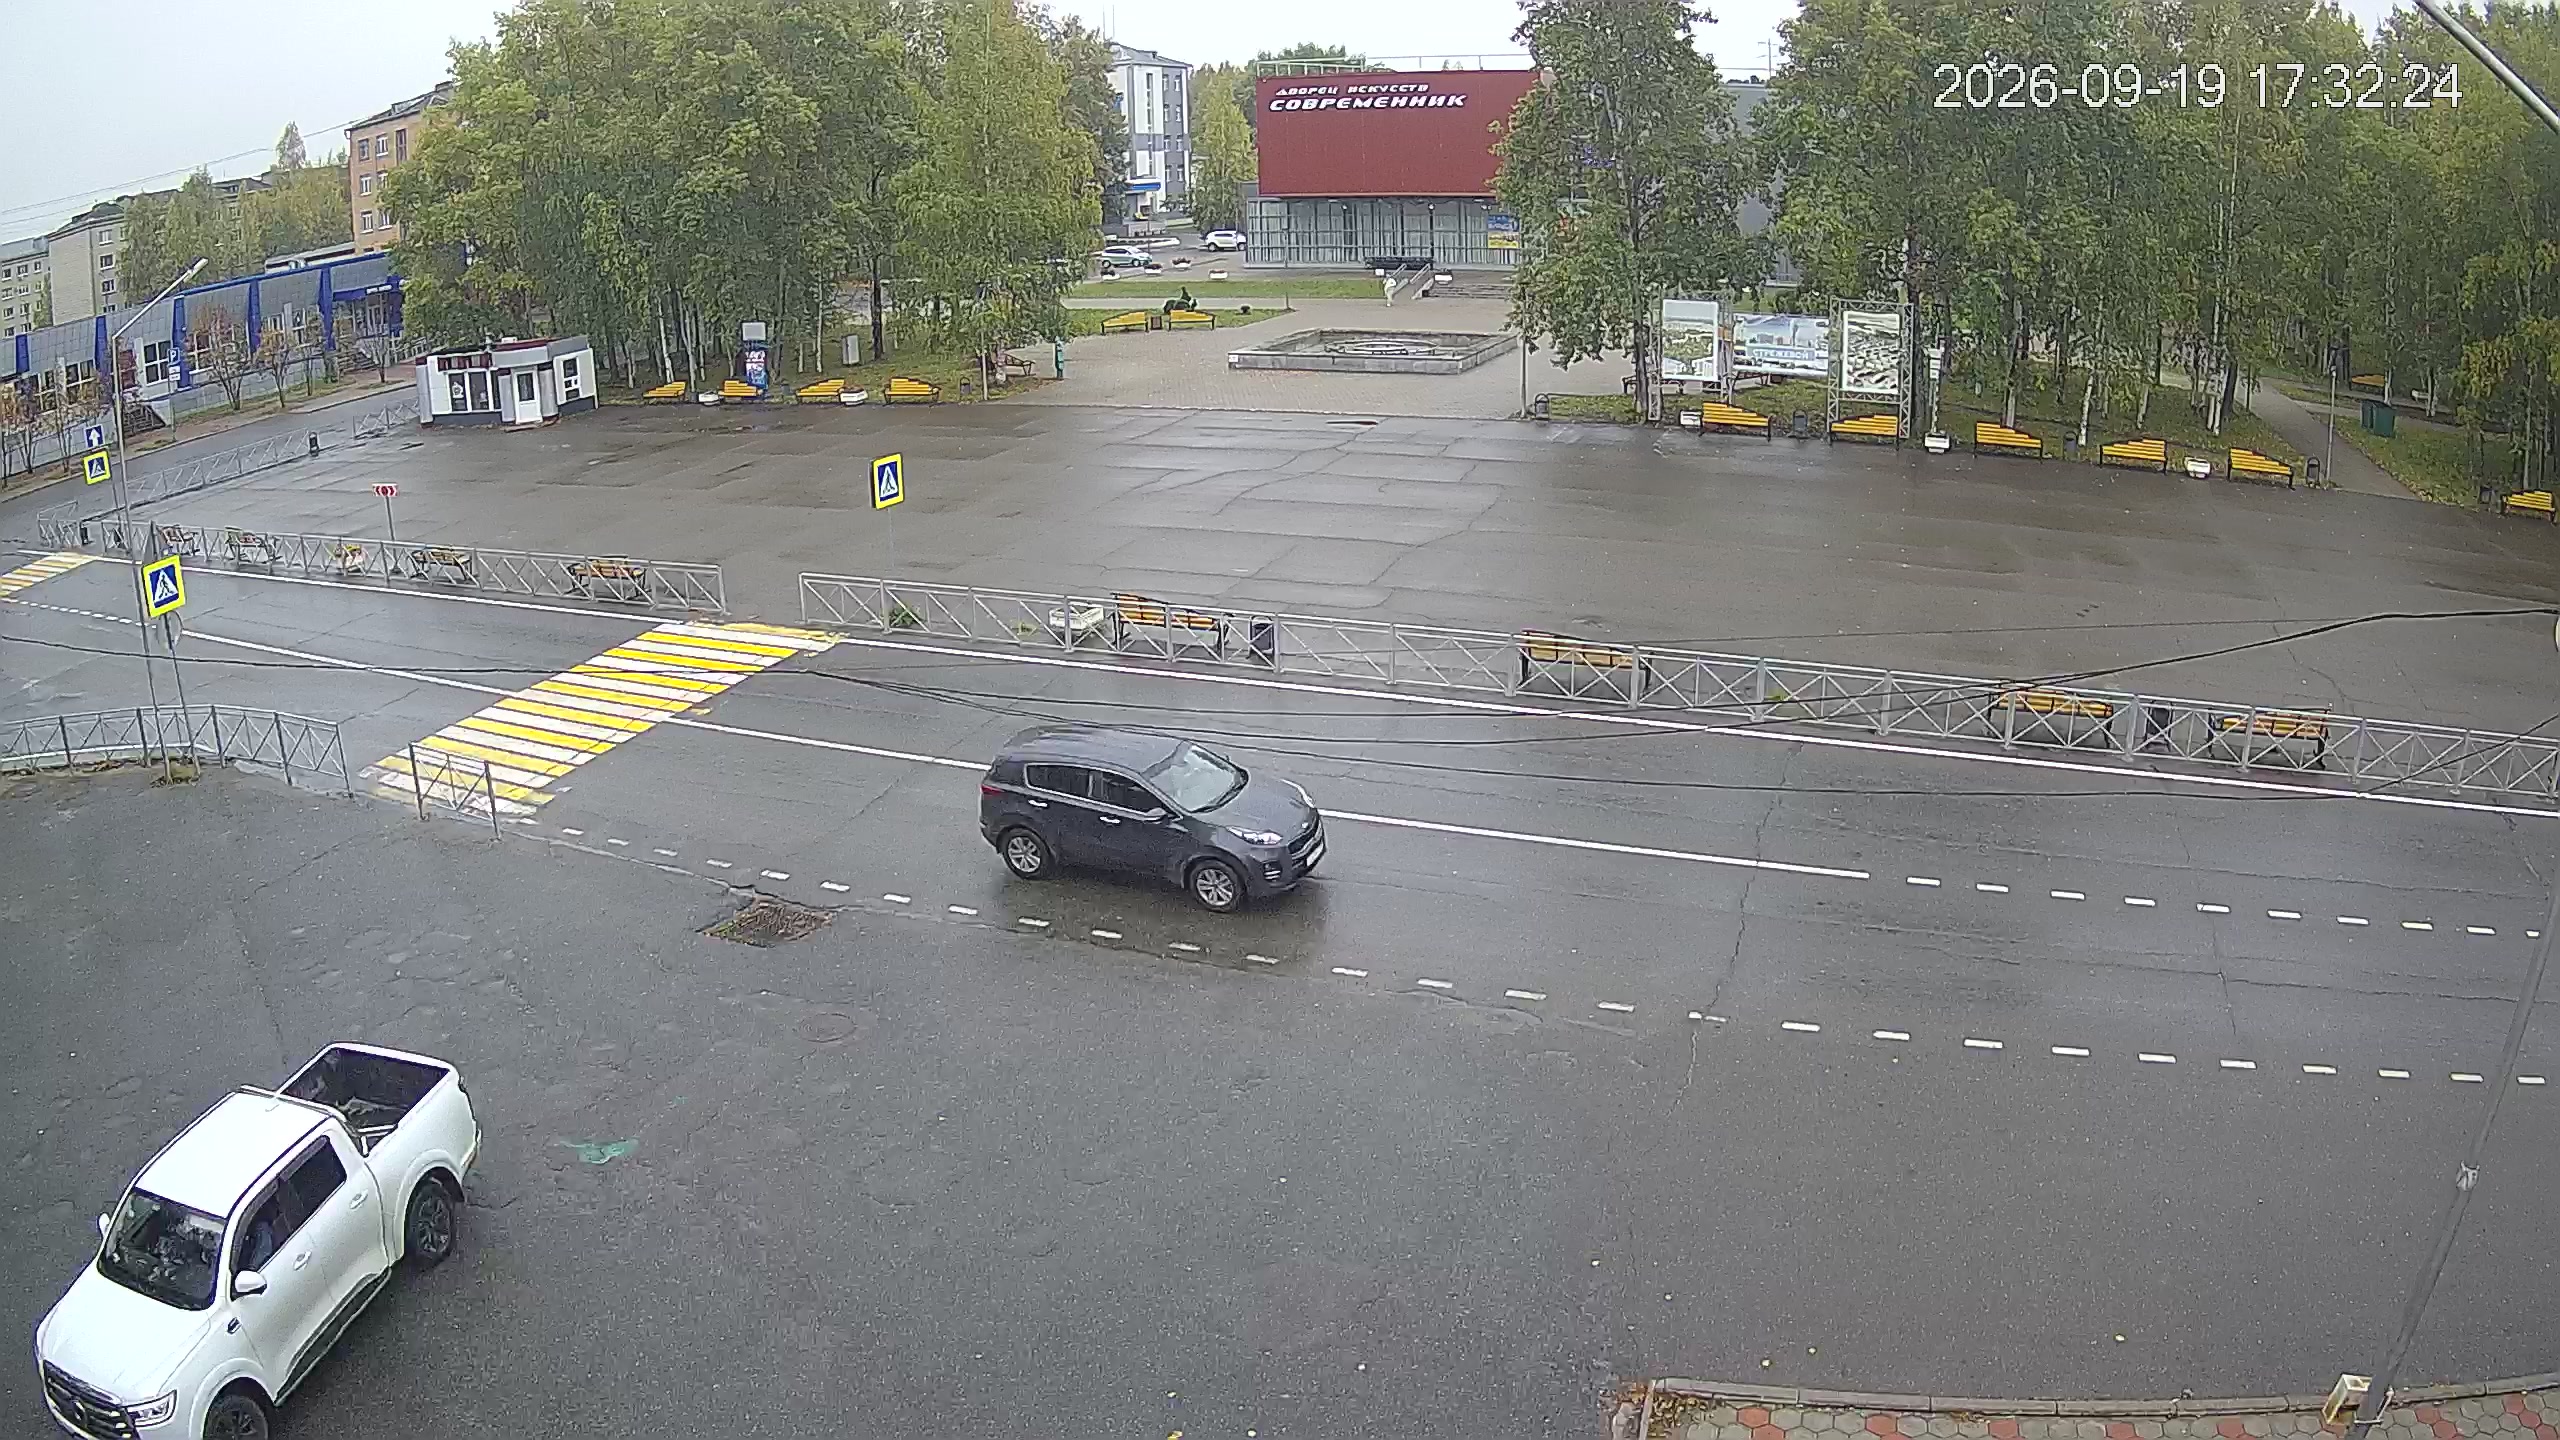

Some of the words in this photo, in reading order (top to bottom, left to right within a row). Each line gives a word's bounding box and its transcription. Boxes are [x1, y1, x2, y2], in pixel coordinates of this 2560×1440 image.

[1276, 86, 1338, 95] ДВОРЕЦ
[1347, 84, 1428, 94] ИСКУССТВ
[1269, 95, 1466, 110] СОВРЕМЕННИК
